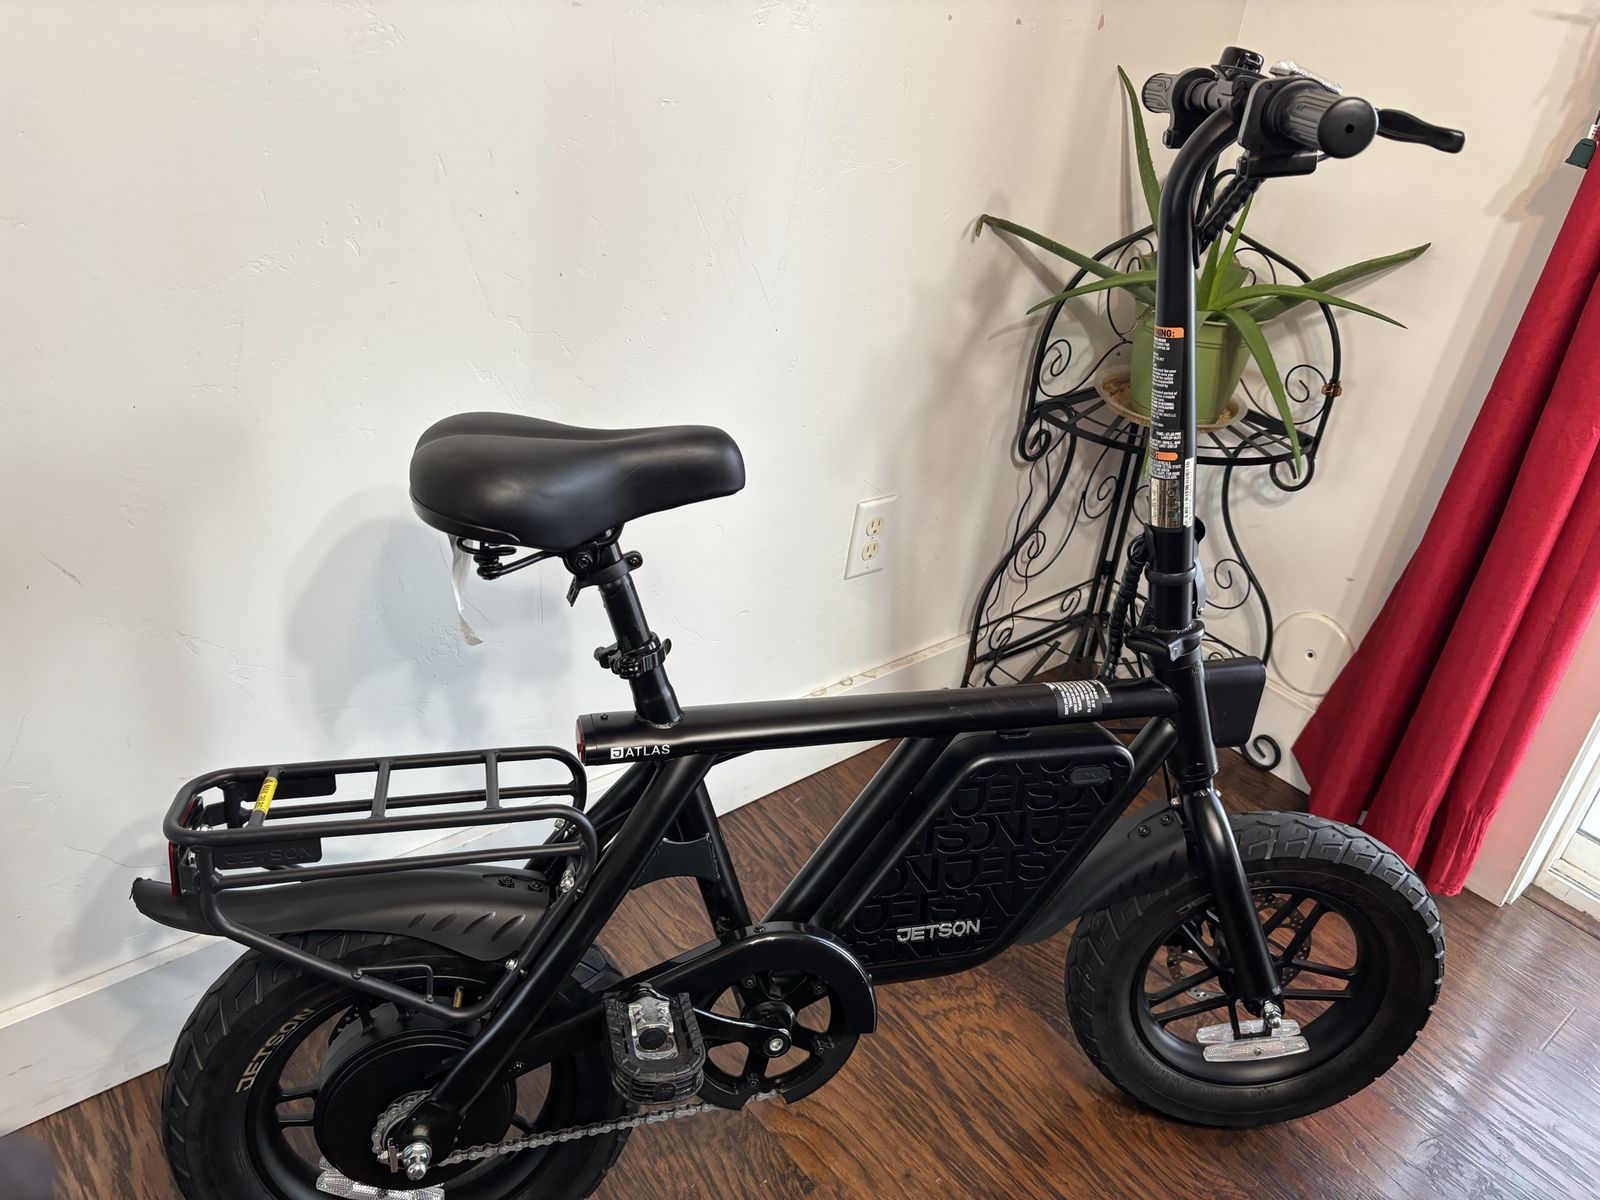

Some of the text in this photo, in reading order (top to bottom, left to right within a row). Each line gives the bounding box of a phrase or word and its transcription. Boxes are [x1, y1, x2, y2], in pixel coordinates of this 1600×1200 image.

[625, 744, 671, 758] ATLAS
[223, 847, 317, 866] JETSON
[897, 919, 981, 943] JETSON
[235, 1008, 316, 1093] JETSON
